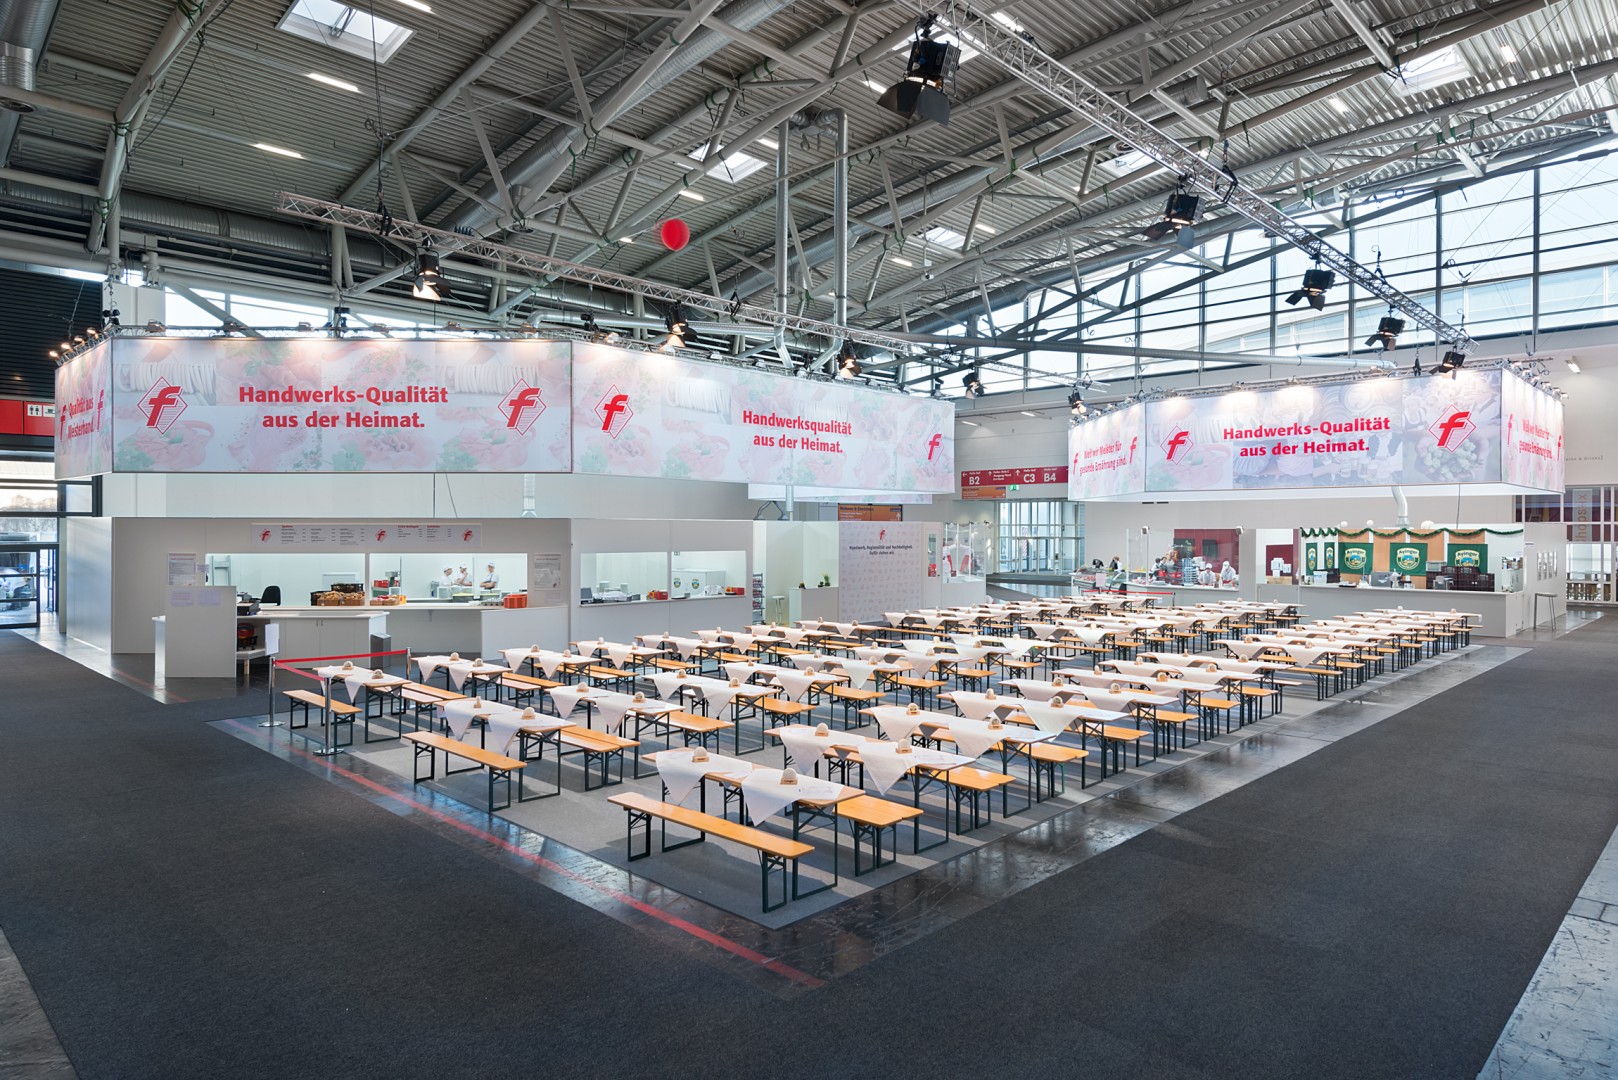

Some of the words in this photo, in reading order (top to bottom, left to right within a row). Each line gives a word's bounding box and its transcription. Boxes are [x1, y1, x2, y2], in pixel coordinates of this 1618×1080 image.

[239, 385, 448, 406] Handwerks-Qualität
[262, 414, 299, 428] aus
[305, 411, 340, 428] der
[346, 411, 425, 428] Heimat.
[743, 410, 852, 435] Handwerksqualität
[1223, 417, 1391, 440] Handwerks-Qualität
[753, 435, 775, 447] aus
[778, 434, 798, 448] der
[801, 437, 843, 453] Heimat.
[1239, 447, 1267, 457] aus
[1271, 442, 1298, 456] der
[1303, 438, 1370, 453] Heimat.
[968, 476, 980, 485] B2
[1023, 473, 1036, 483] C3
[1043, 473, 1056, 482] B4
